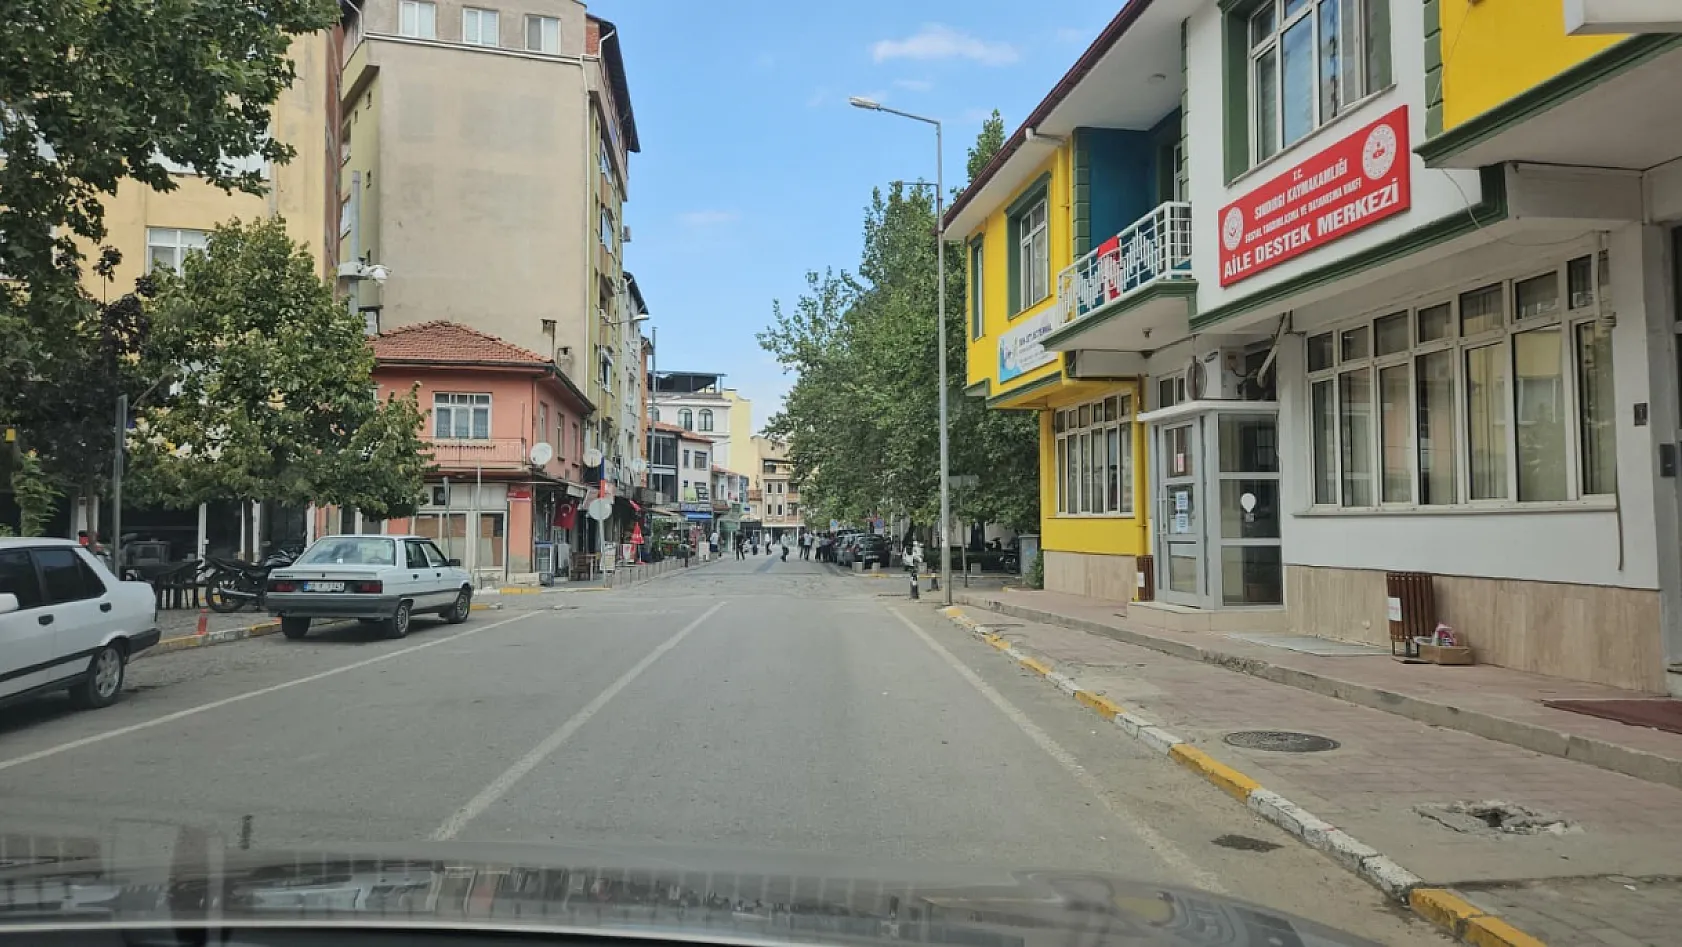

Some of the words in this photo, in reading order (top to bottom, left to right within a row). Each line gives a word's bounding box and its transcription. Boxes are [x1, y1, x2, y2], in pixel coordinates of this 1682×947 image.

[1224, 250, 1252, 279] AİLE
[1255, 222, 1312, 265] DESTEK
[1316, 178, 1399, 237] MERKEZİ
